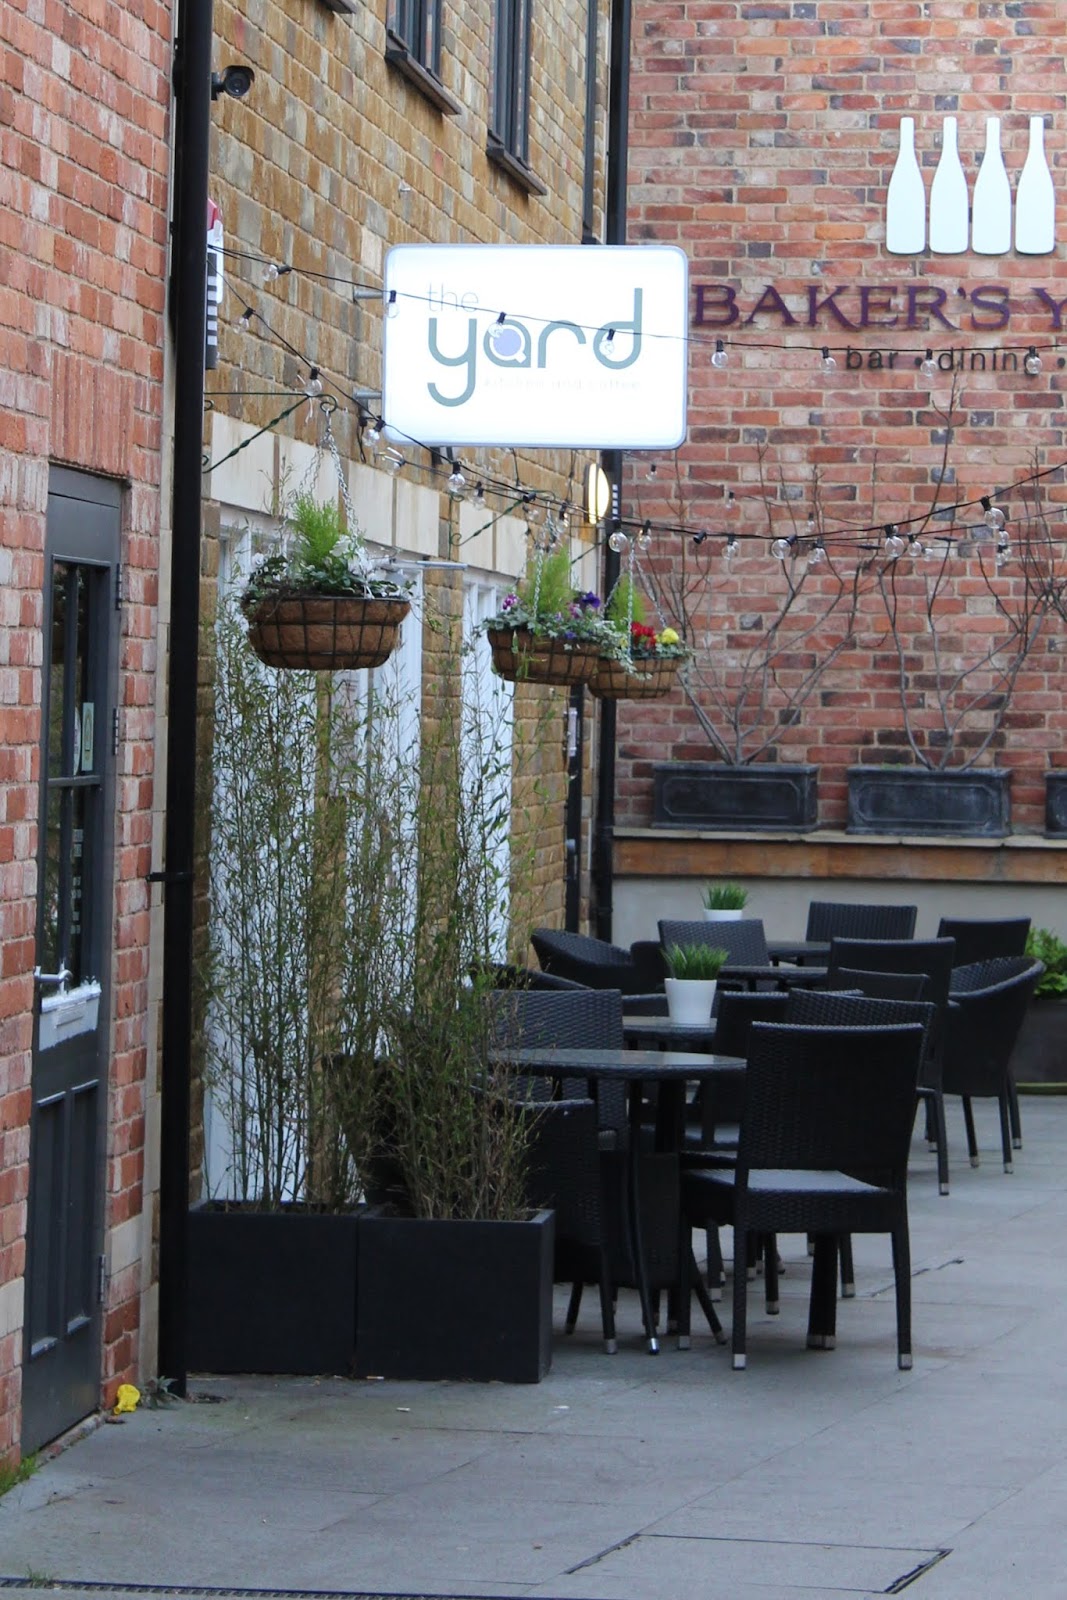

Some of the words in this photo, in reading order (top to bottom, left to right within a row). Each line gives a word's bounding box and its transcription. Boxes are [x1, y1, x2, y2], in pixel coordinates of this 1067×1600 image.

[427, 282, 479, 312] the
[691, 284, 1010, 331] BAKER'S
[427, 288, 643, 407] yard
[846, 345, 899, 370] bar
